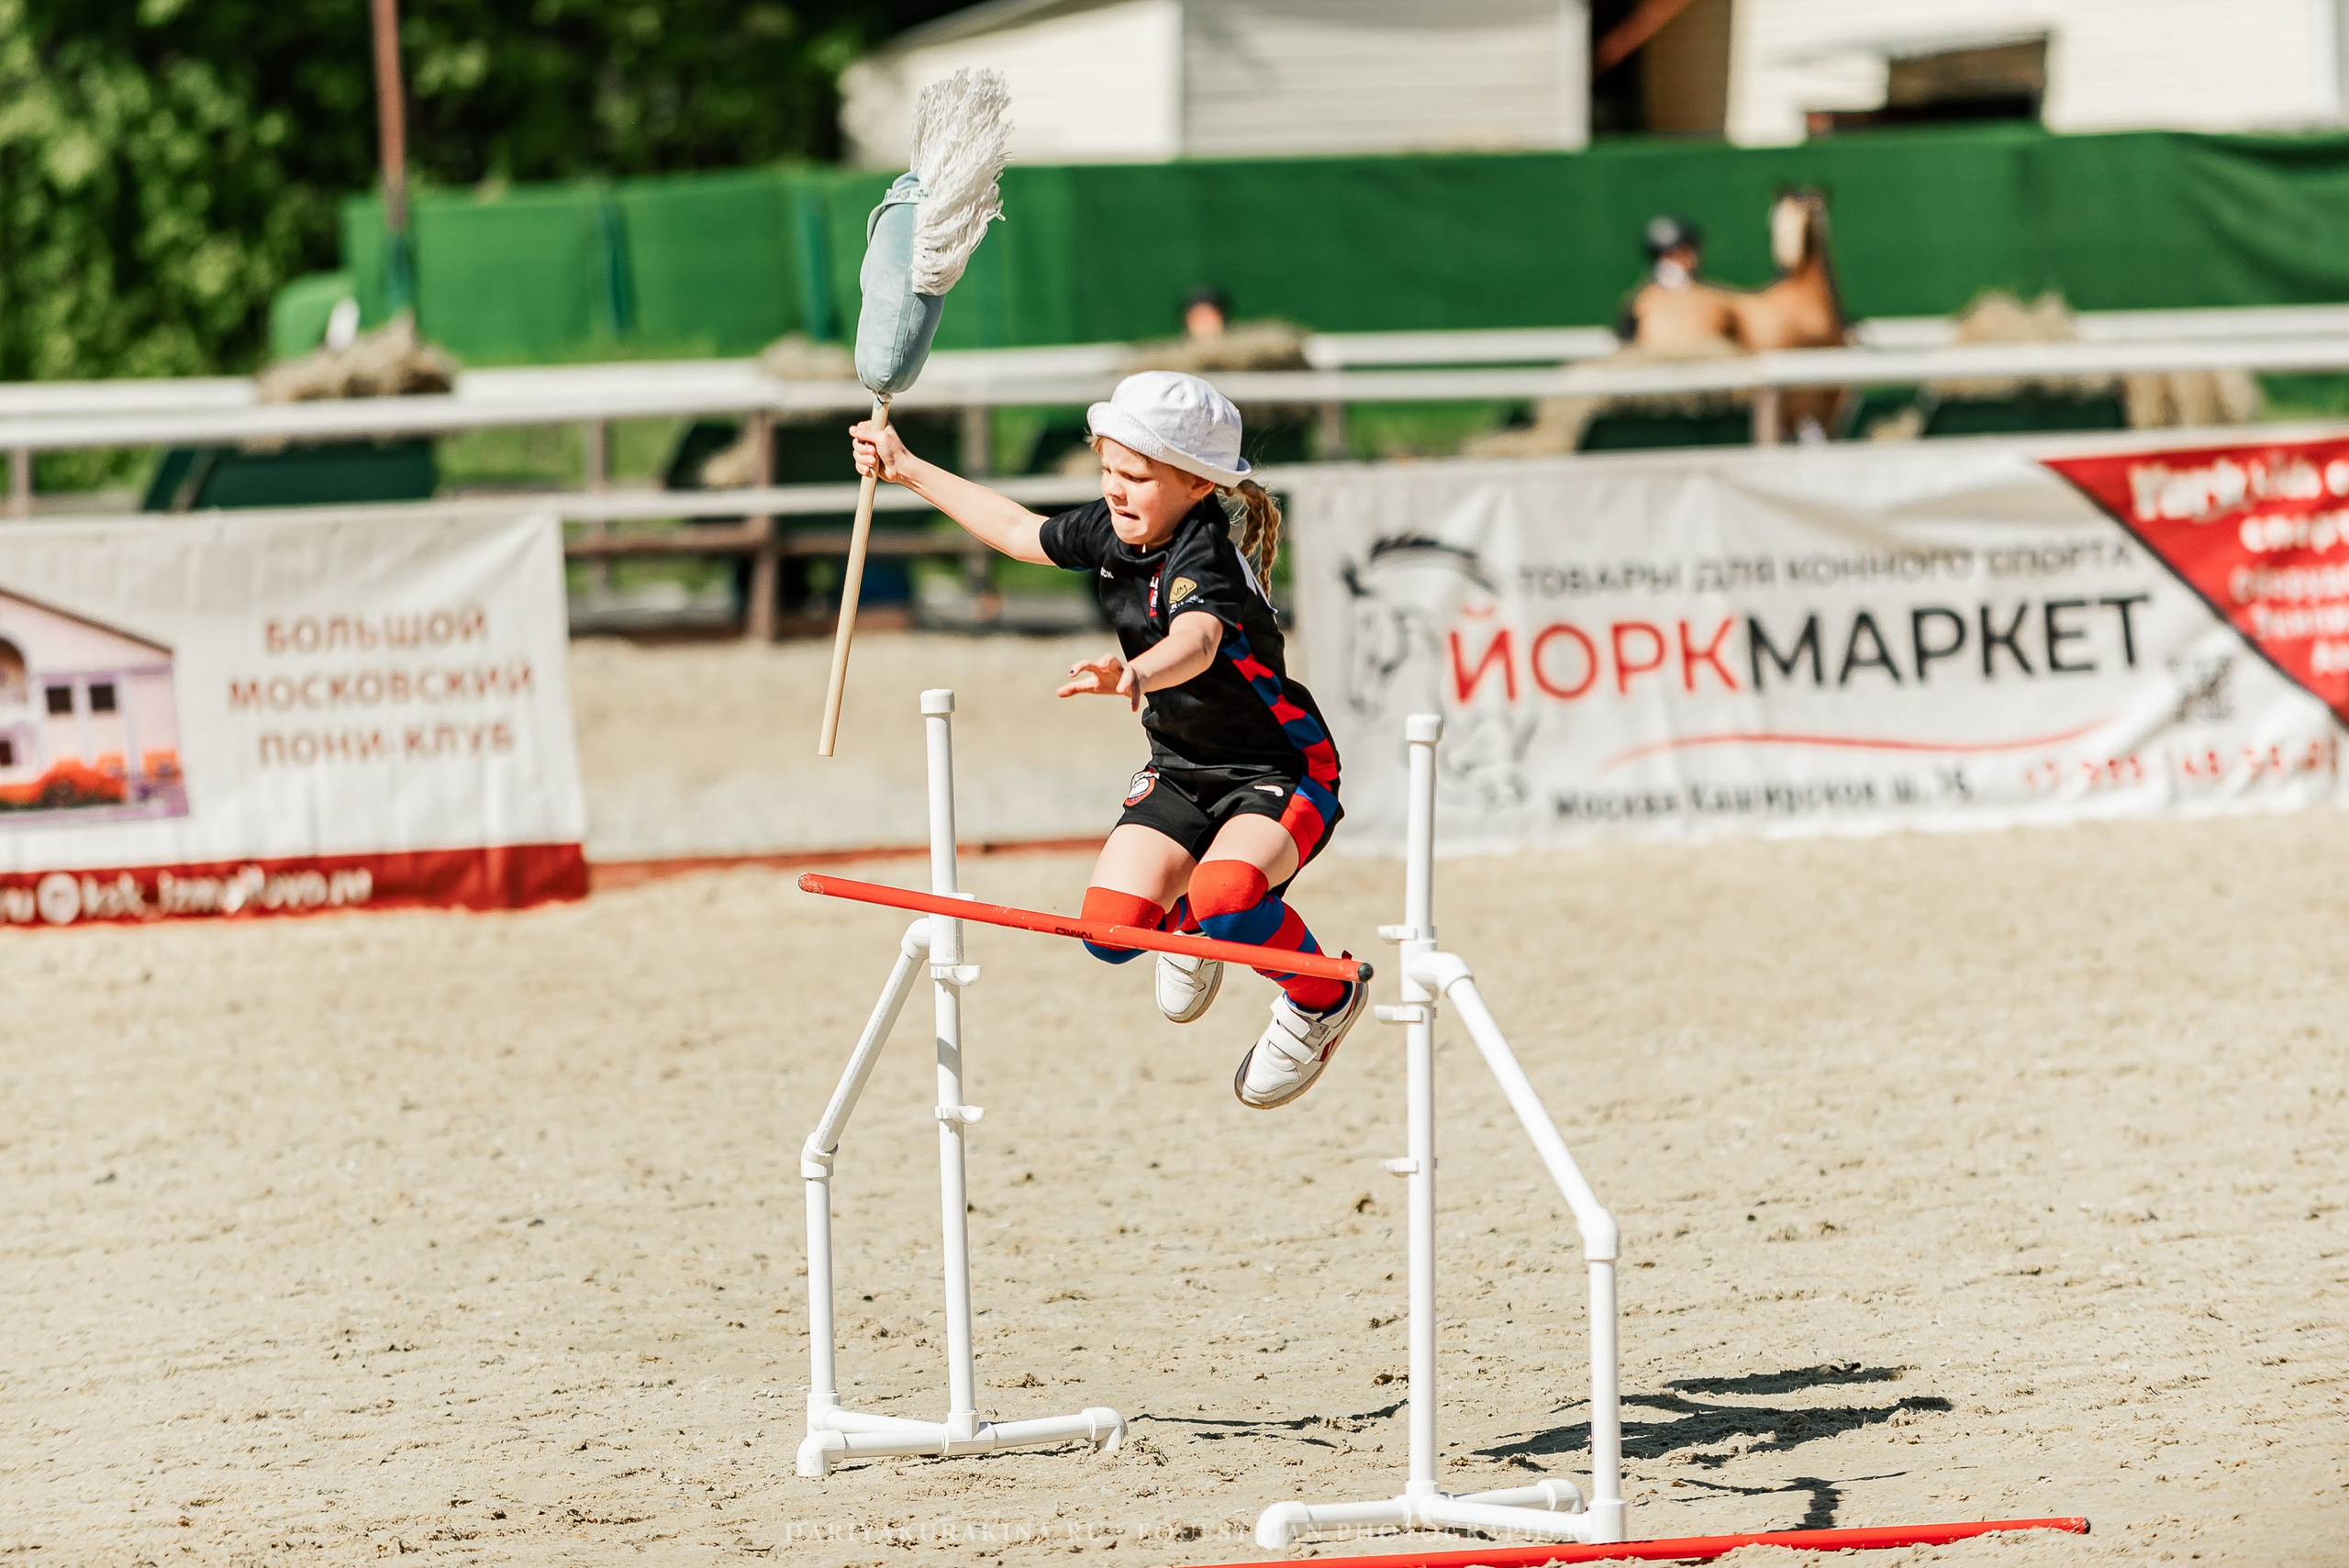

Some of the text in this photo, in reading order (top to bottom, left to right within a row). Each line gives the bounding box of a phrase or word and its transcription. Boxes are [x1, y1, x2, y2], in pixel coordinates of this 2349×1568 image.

[1520, 539, 2134, 599] ТОВАРЫ ДЛЯ КОННОГО СПОРТА
[263, 605, 488, 655] БОЛЬШОЙ
[1449, 593, 2151, 705] ЙОРКМАРКЕТ
[228, 660, 533, 713] МОСКОВСКИЙ
